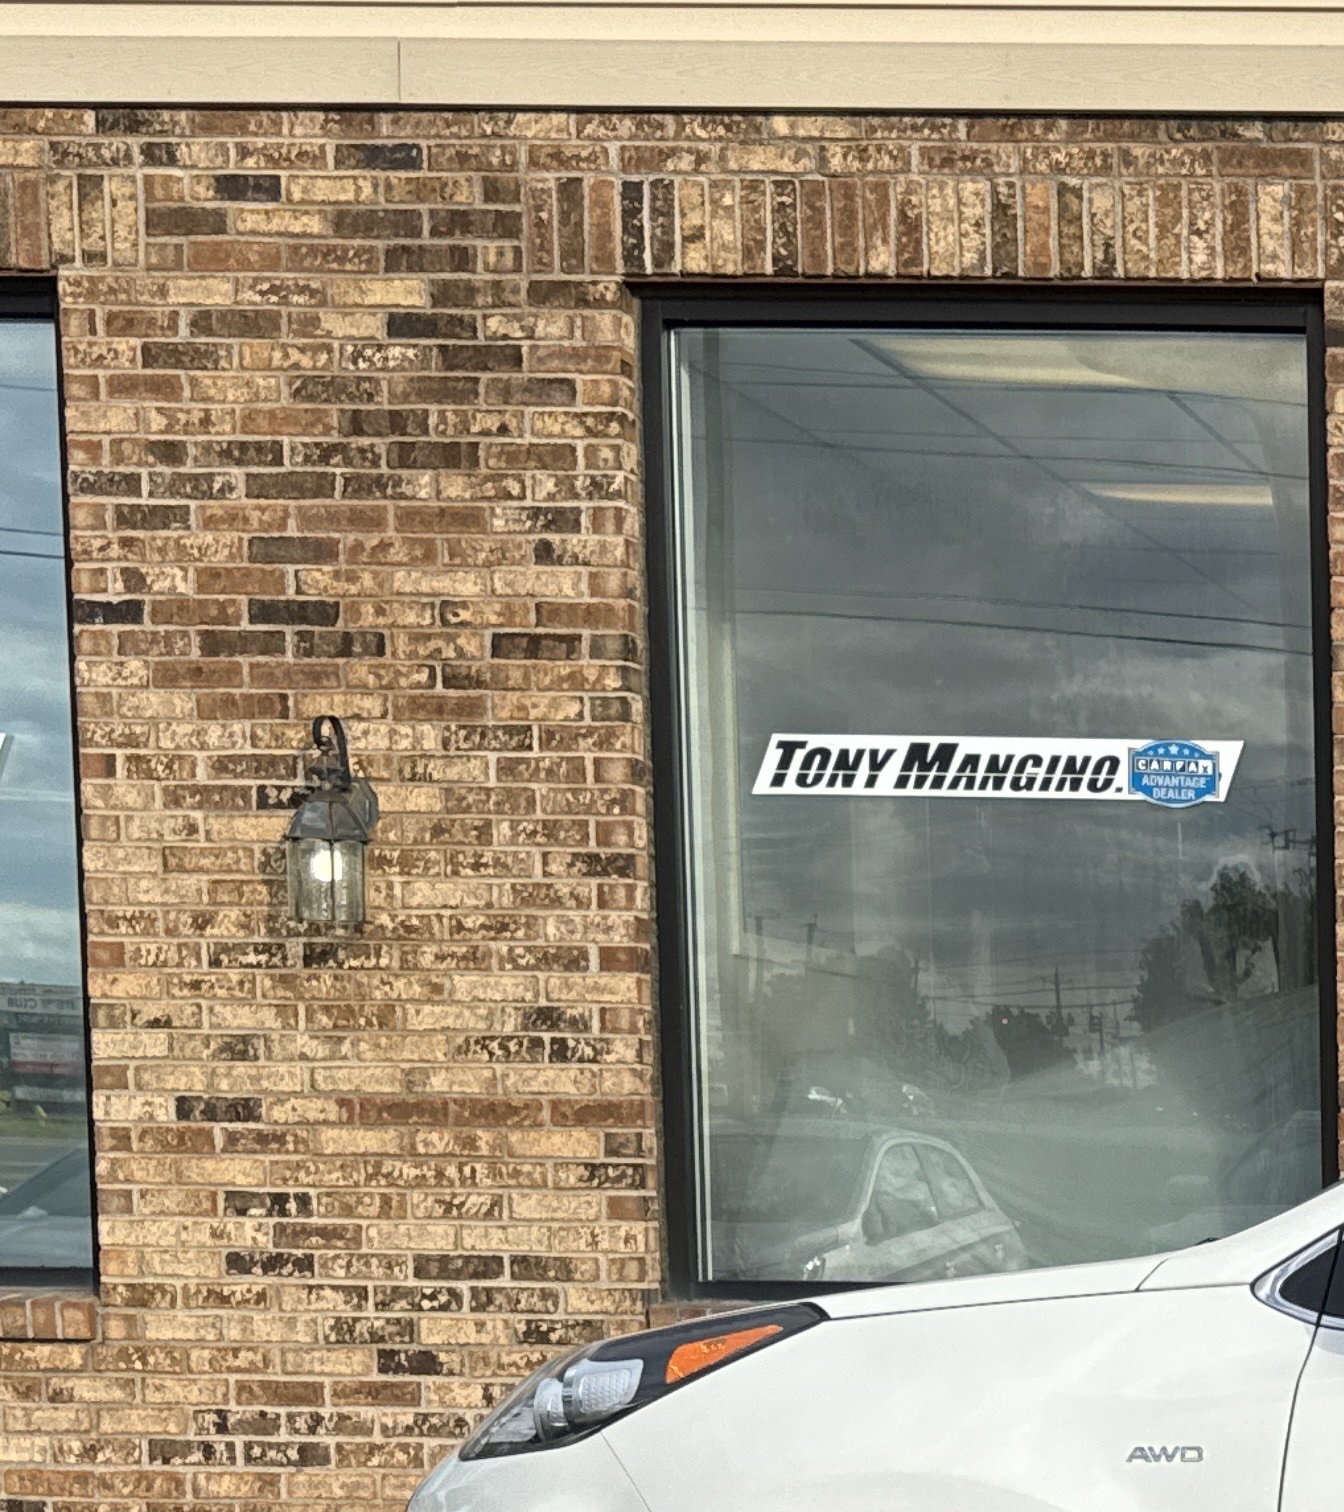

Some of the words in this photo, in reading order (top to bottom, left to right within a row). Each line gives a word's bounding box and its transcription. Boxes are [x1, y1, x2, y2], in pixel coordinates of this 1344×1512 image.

[769, 740, 897, 788] TONY
[1136, 758, 1212, 774] CARFAX
[1141, 774, 1207, 789] ADVANTAGE
[1152, 787, 1196, 800] DEALER
[1125, 1446, 1204, 1462] AWD
